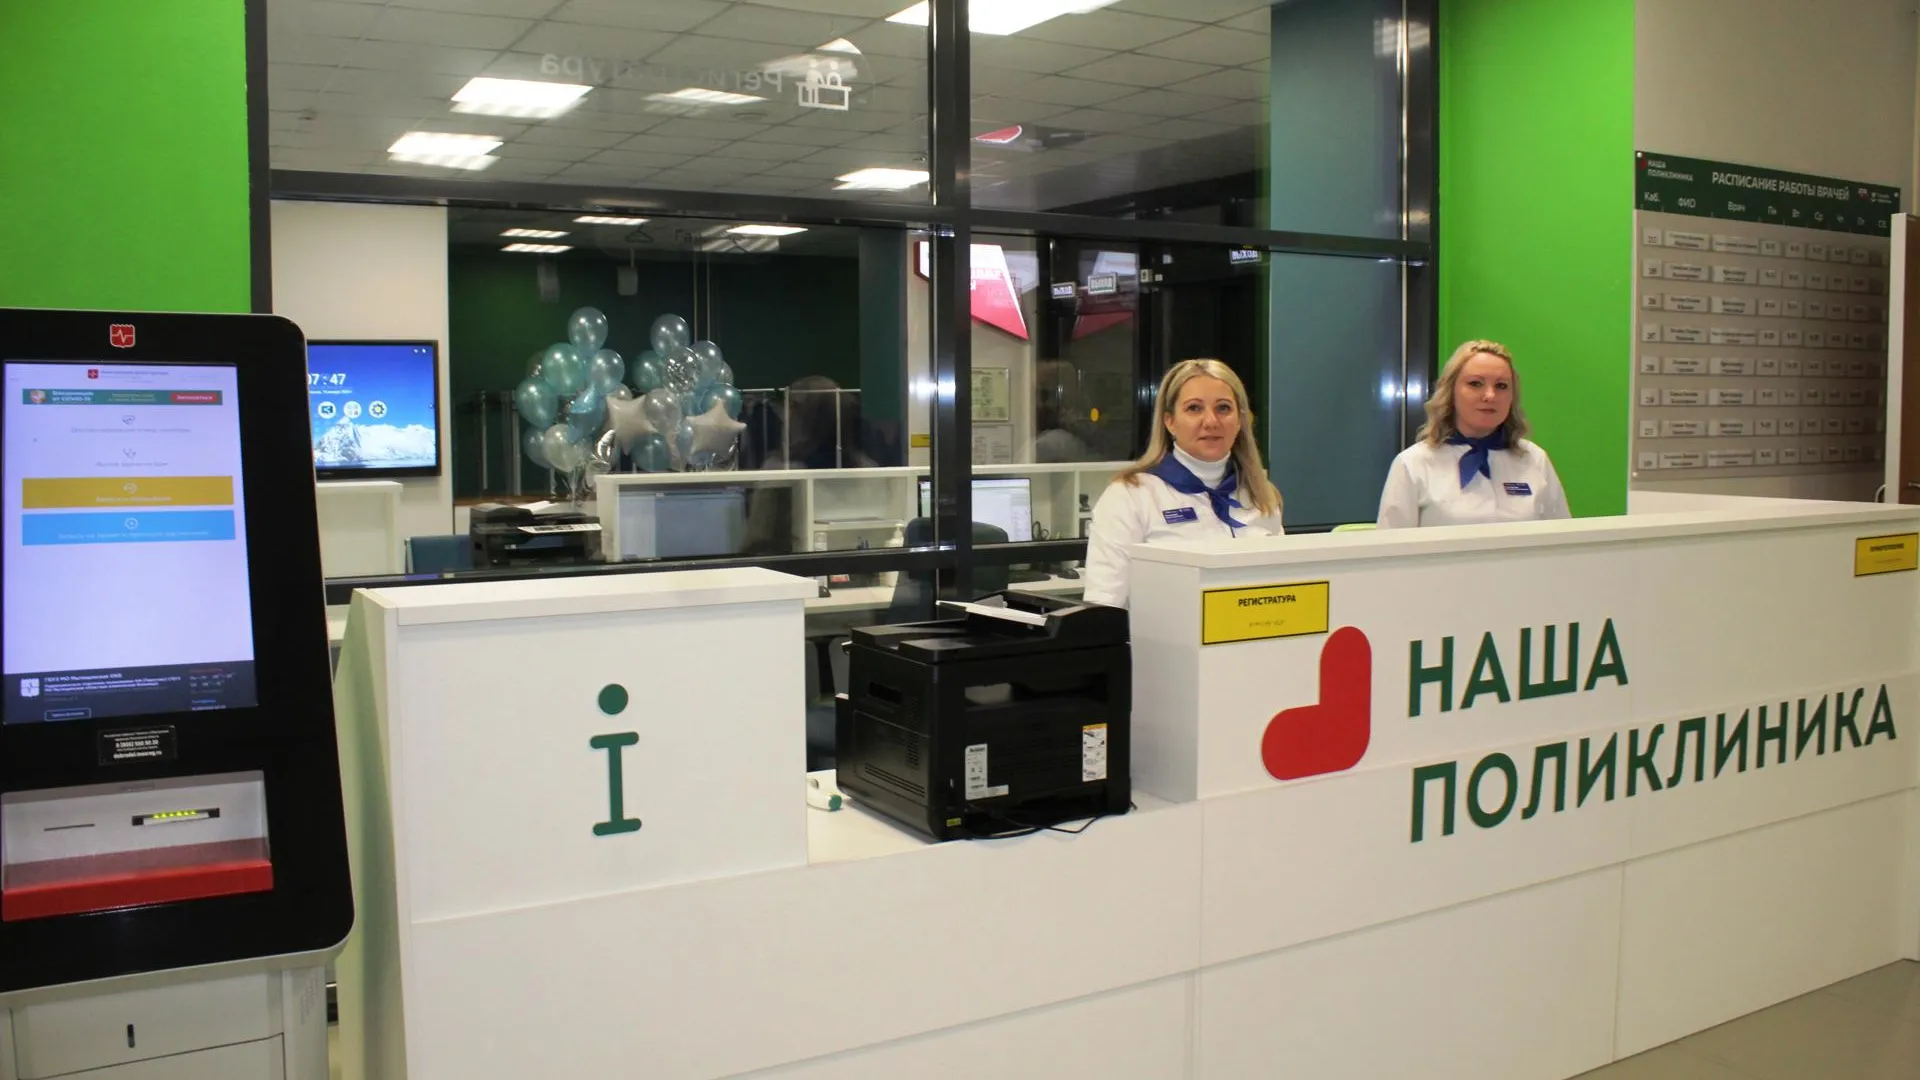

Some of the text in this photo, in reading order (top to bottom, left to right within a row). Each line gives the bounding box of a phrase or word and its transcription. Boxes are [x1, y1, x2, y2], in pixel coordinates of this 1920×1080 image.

[1711, 171, 1849, 201] РАСПИСАНИЕ РАБОТЫ ВРАЧЕЙ
[1677, 198, 1696, 209] ФИО
[1727, 201, 1746, 213] Врач
[1238, 595, 1297, 607] РЕГИСТРАТУРА
[1408, 617, 1629, 718] НАША
[1410, 683, 1897, 844] ПОЛИКЛИНИКА
